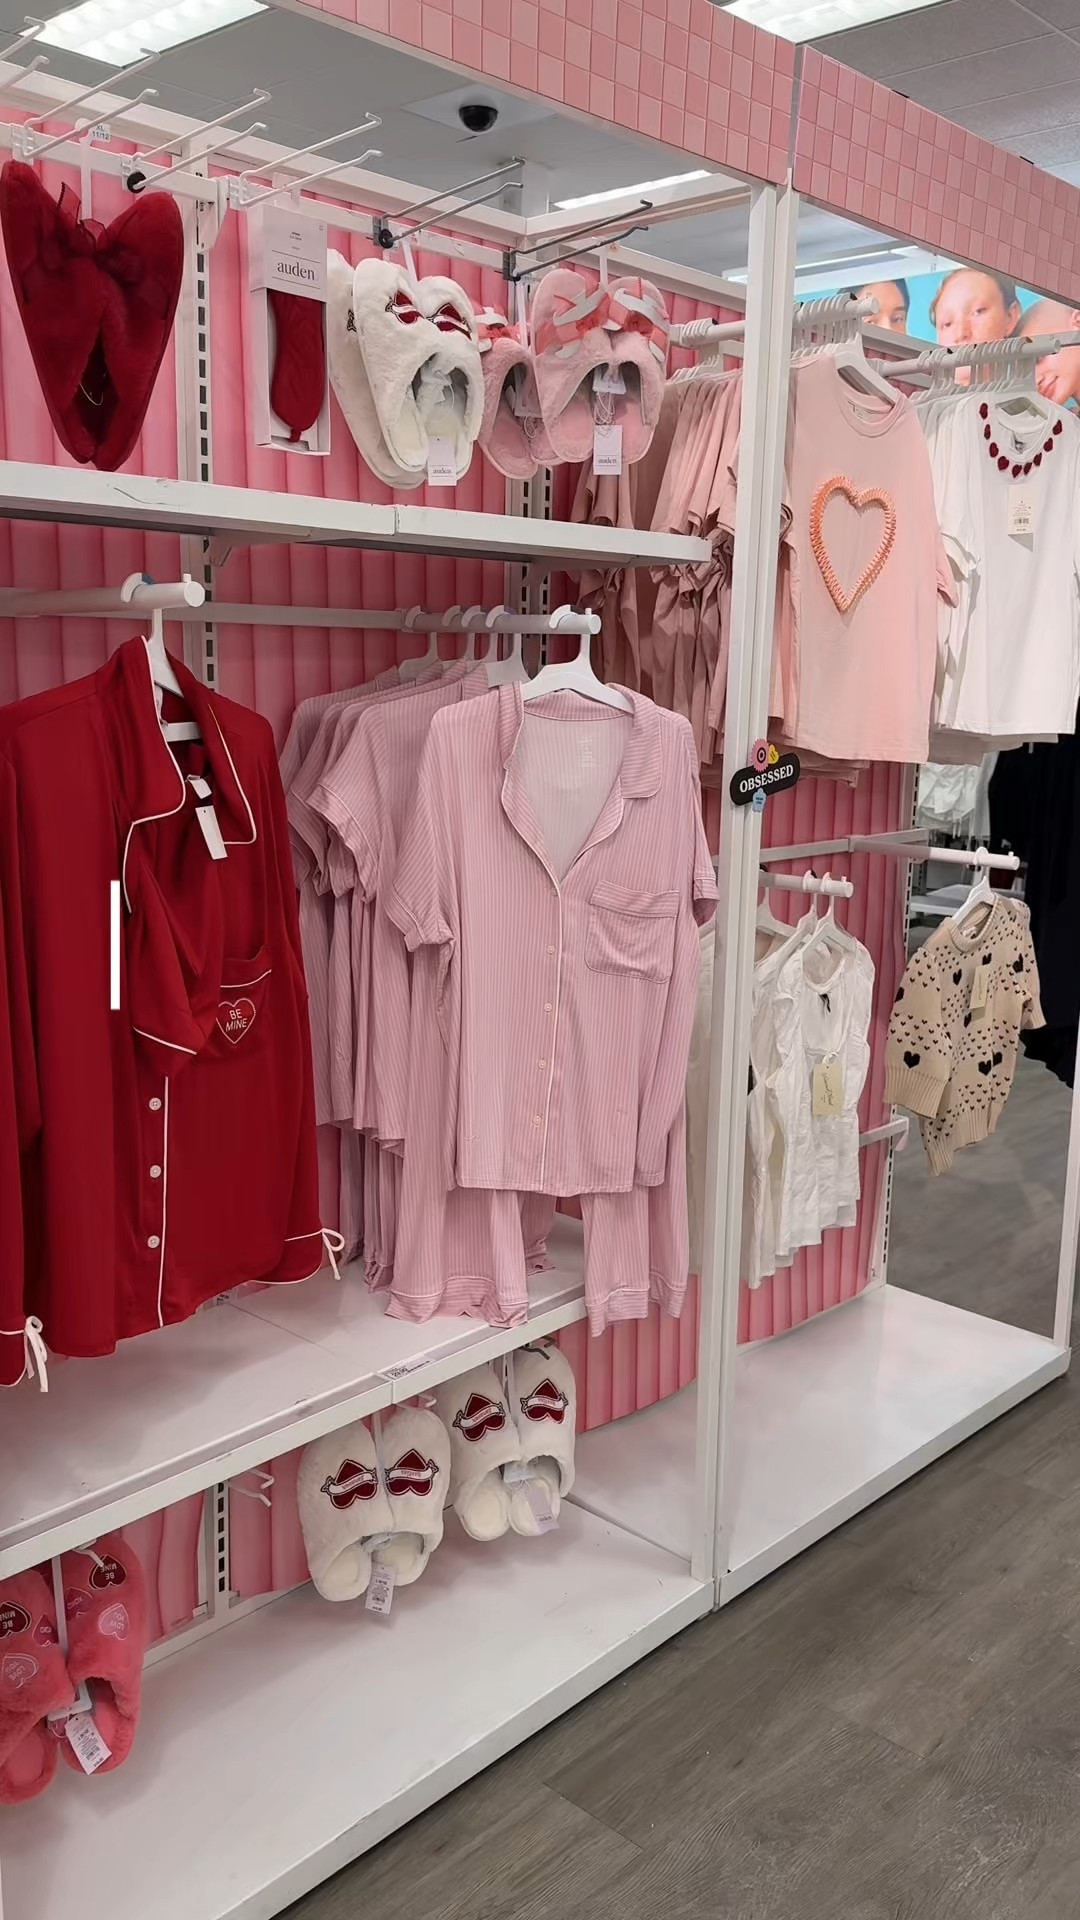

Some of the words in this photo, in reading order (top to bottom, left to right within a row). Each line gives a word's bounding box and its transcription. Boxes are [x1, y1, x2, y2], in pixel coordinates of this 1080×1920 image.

[277, 261, 315, 281] auden
[739, 764, 794, 793] OBSESSED
[229, 1008, 243, 1020] BE
[225, 1017, 248, 1032] MINE
[105, 1571, 115, 1580] BE
[2, 1619, 13, 1629] BE
